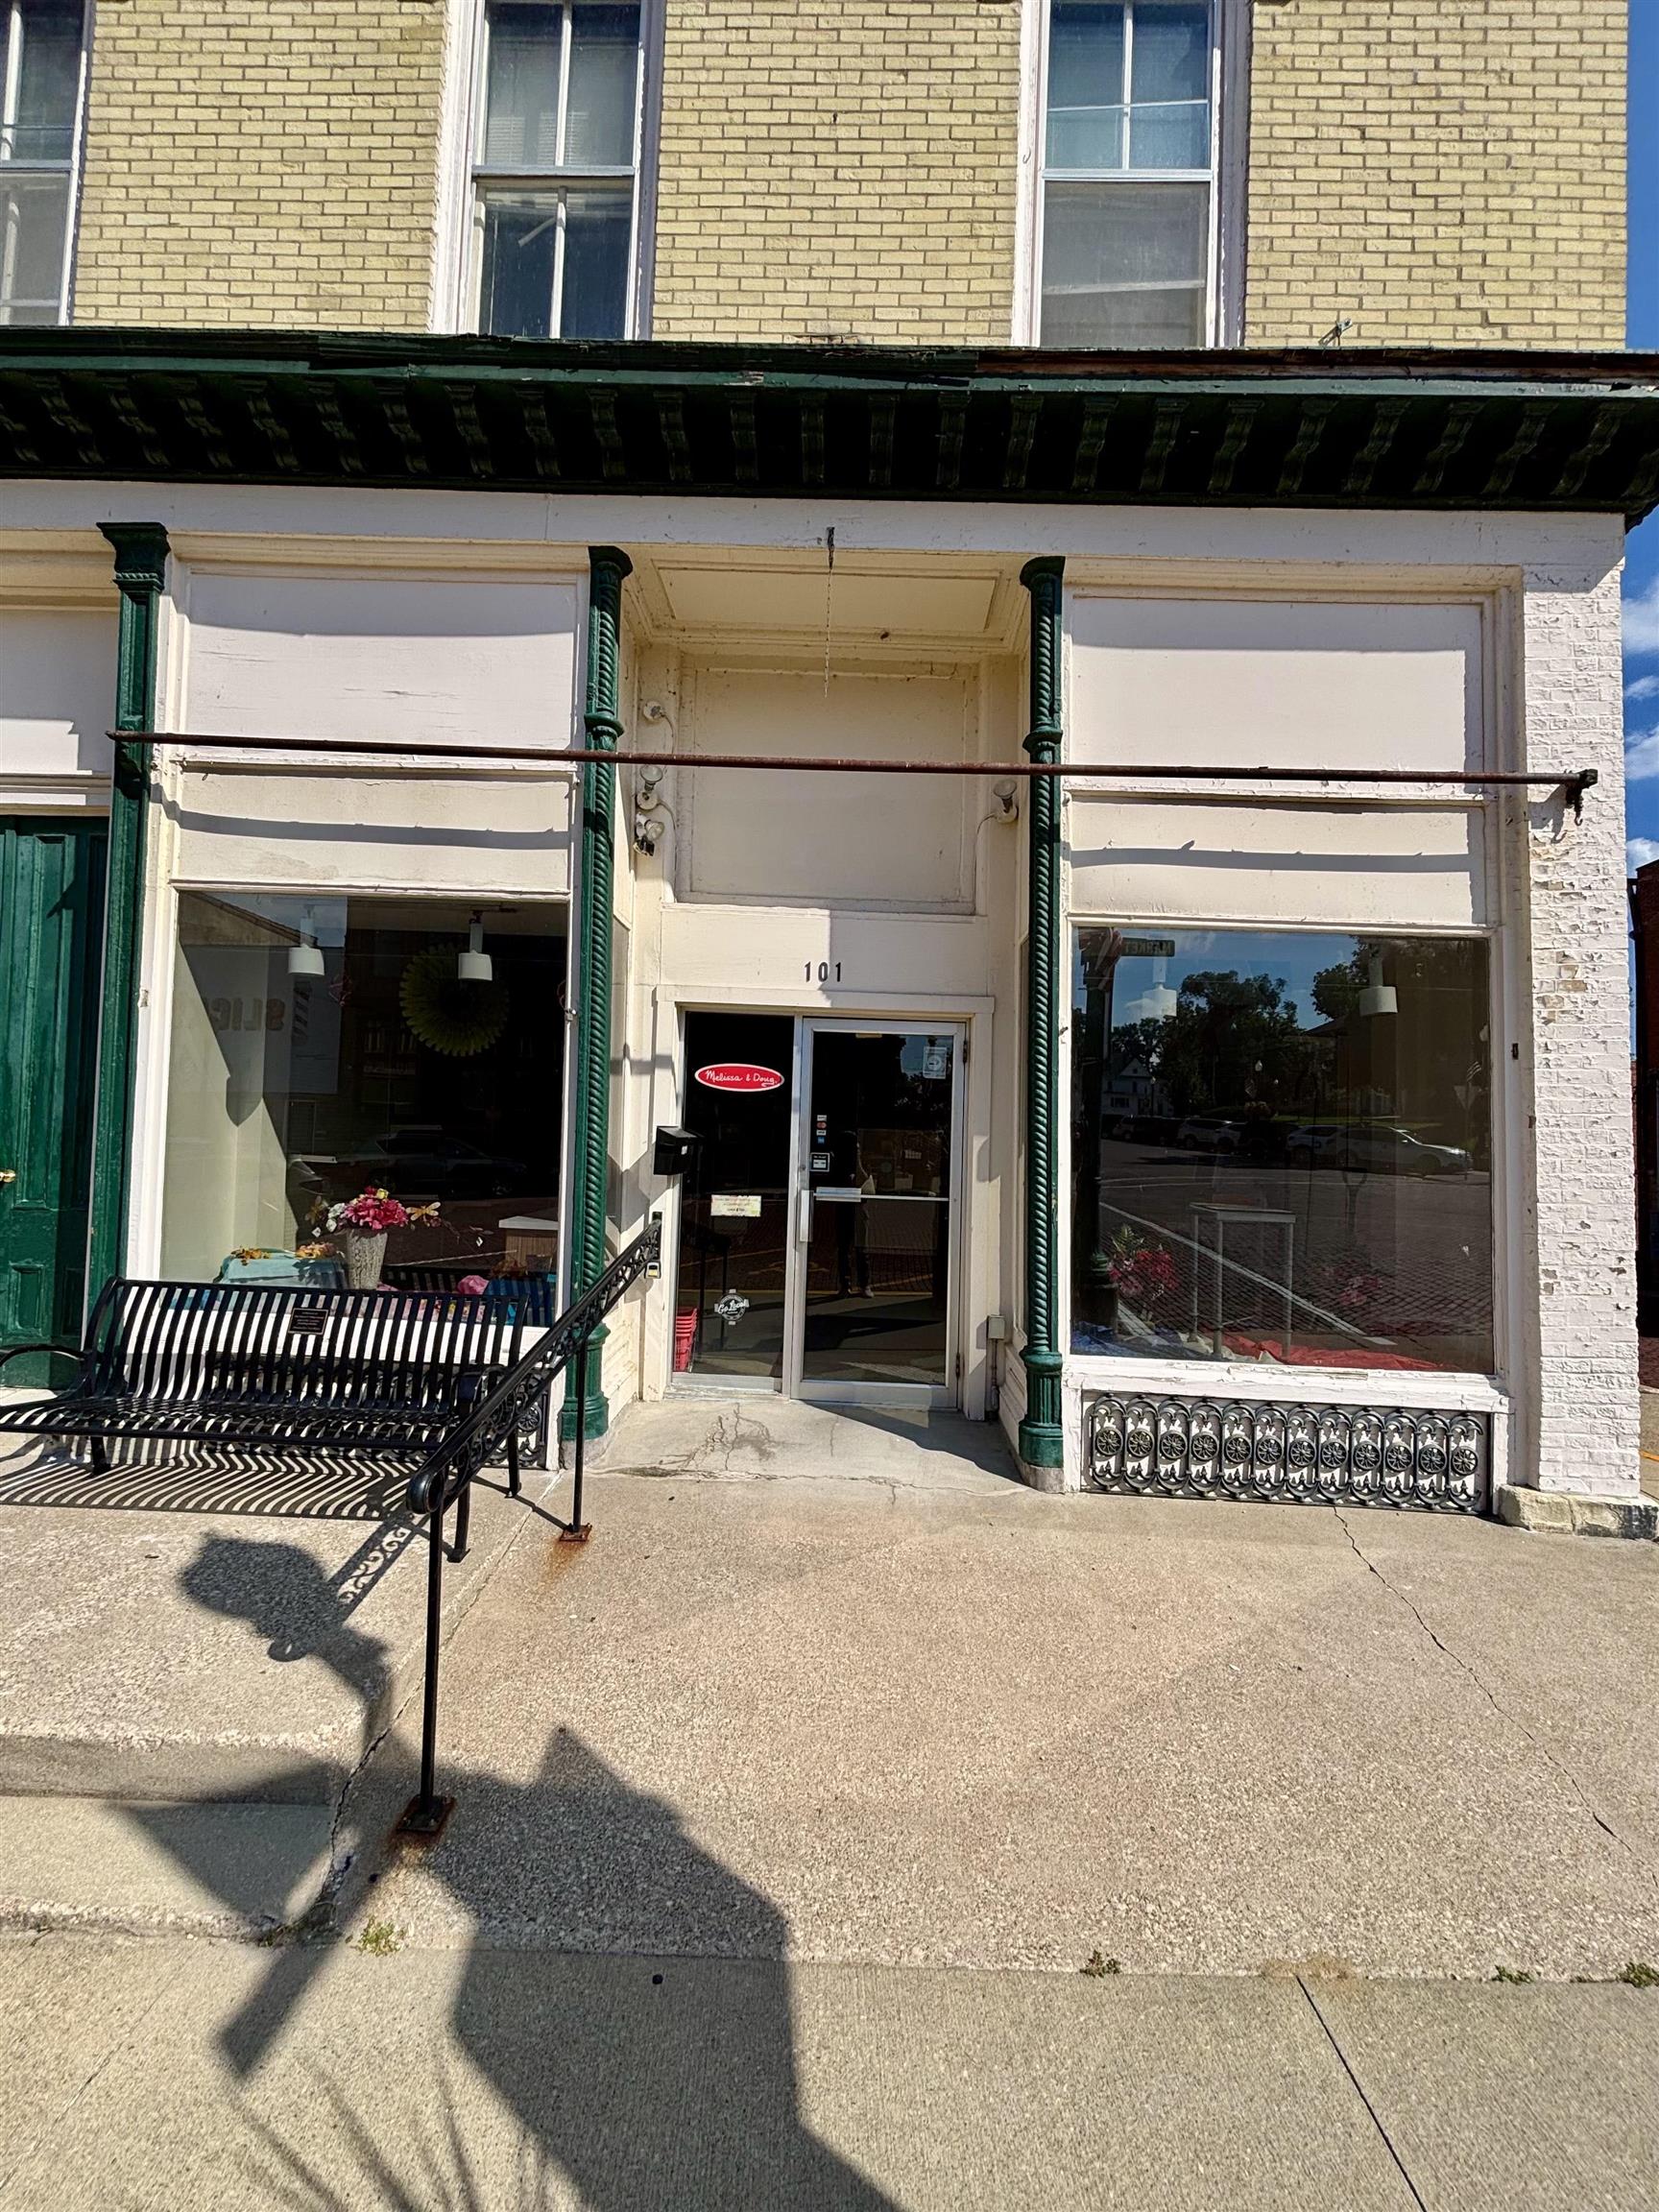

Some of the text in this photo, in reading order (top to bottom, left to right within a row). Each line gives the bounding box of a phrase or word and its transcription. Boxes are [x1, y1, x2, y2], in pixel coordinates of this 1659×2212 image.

[805, 961, 841, 982] 101
[705, 1070, 743, 1083] Melissa
[745, 1073, 752, 1082] &
